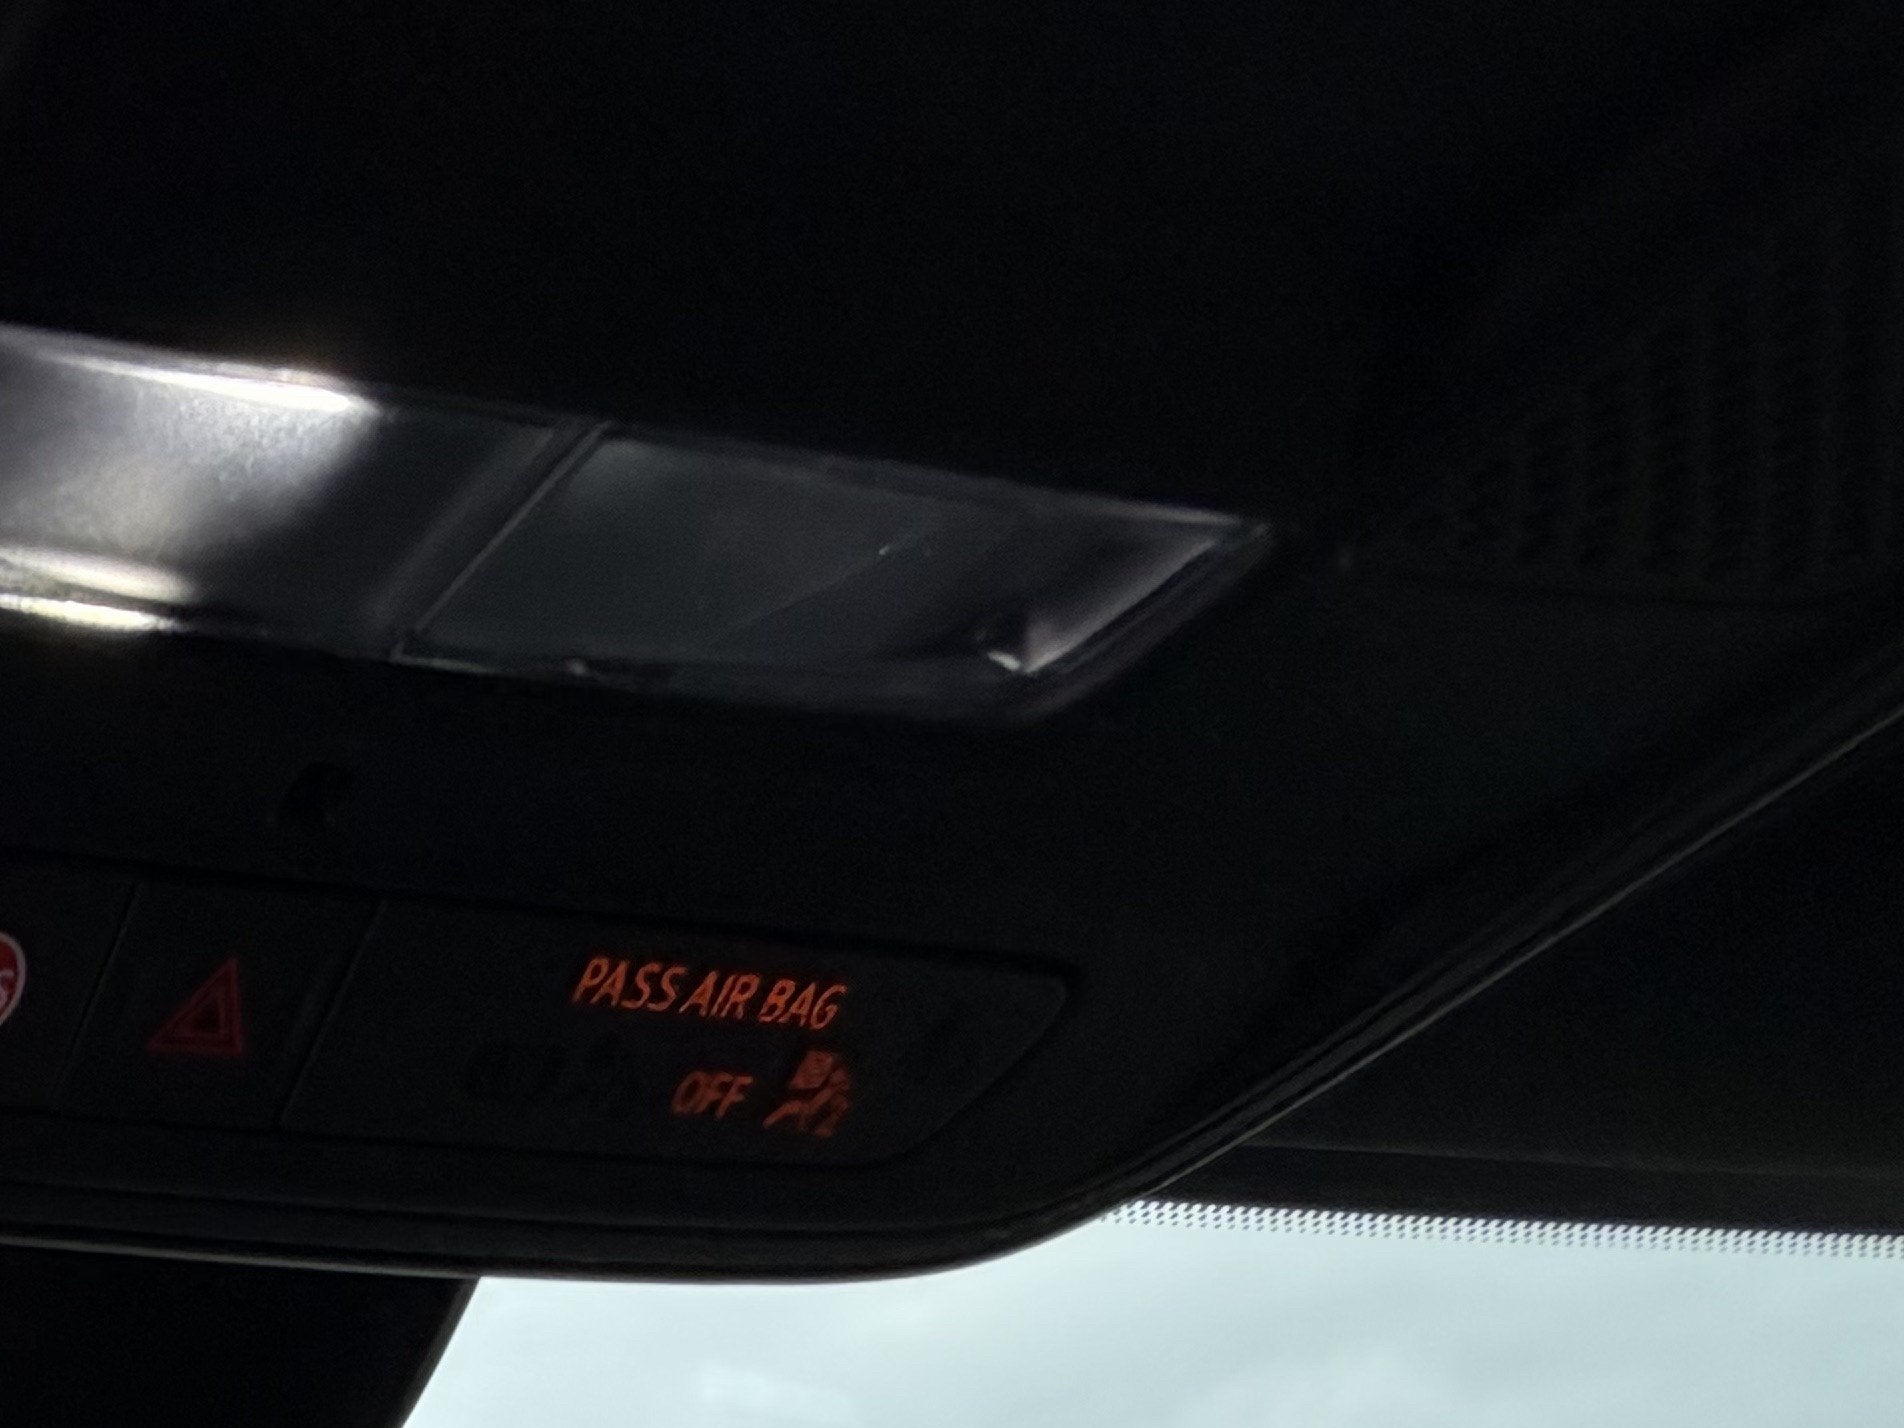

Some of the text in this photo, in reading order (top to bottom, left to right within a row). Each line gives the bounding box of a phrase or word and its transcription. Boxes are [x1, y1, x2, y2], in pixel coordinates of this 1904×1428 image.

[572, 956, 848, 1031] PASS AIR BAG
[671, 1069, 754, 1119] OFF
